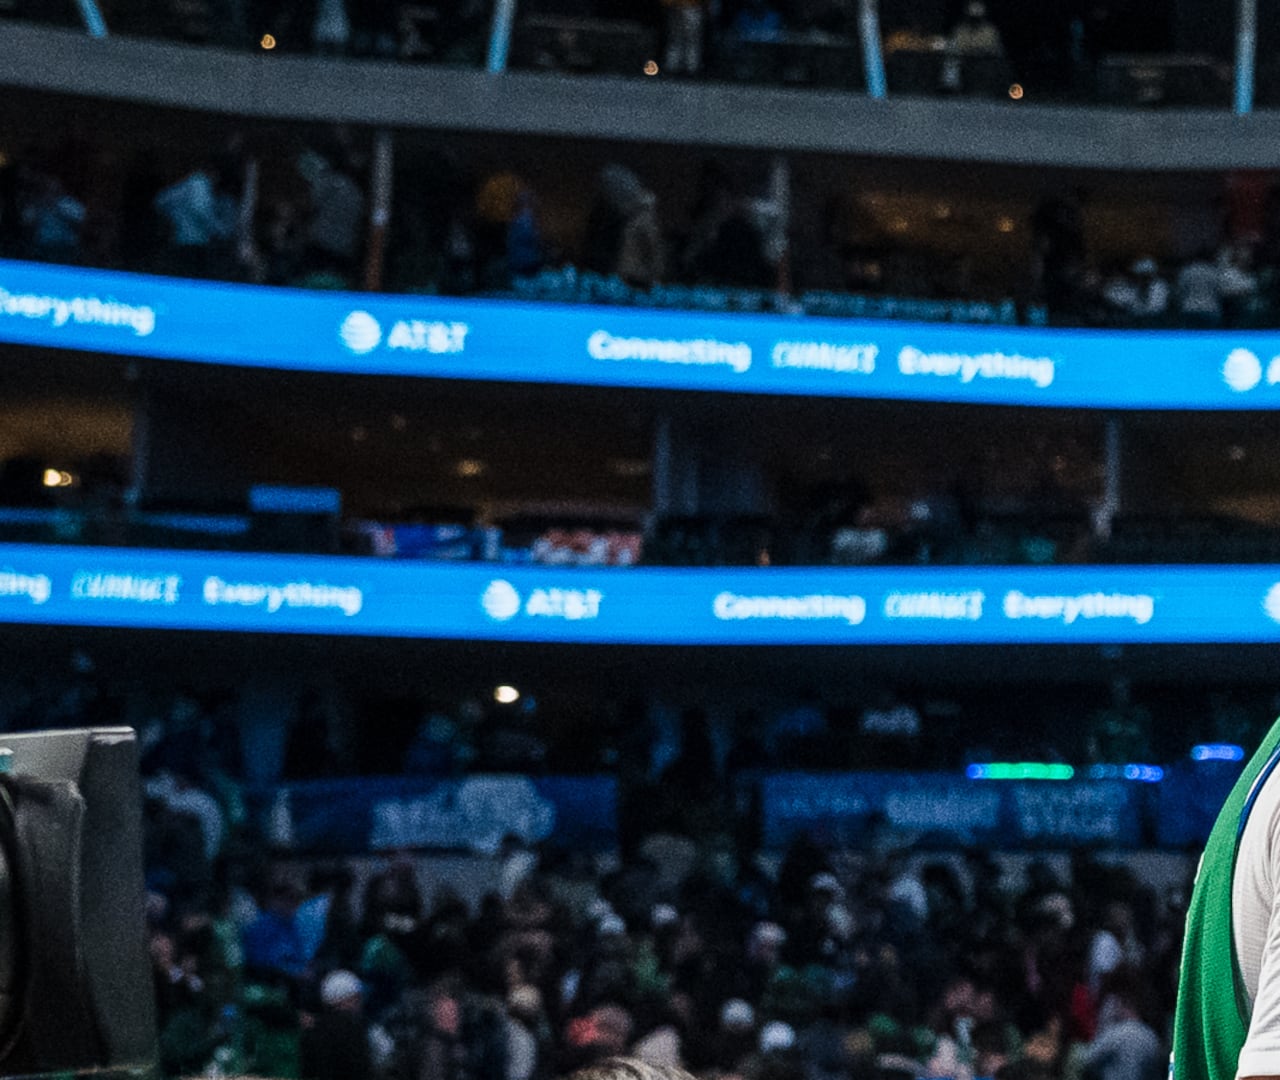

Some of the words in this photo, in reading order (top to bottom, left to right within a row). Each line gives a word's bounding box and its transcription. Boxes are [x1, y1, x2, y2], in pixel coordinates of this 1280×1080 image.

[387, 319, 469, 354] AT&T
[589, 331, 753, 373] Connecting
[898, 345, 1055, 388] Everything
[203, 576, 363, 617] Everything
[525, 588, 604, 621] AT&T
[713, 593, 866, 625] Connecting
[1004, 591, 1155, 625] Everything
